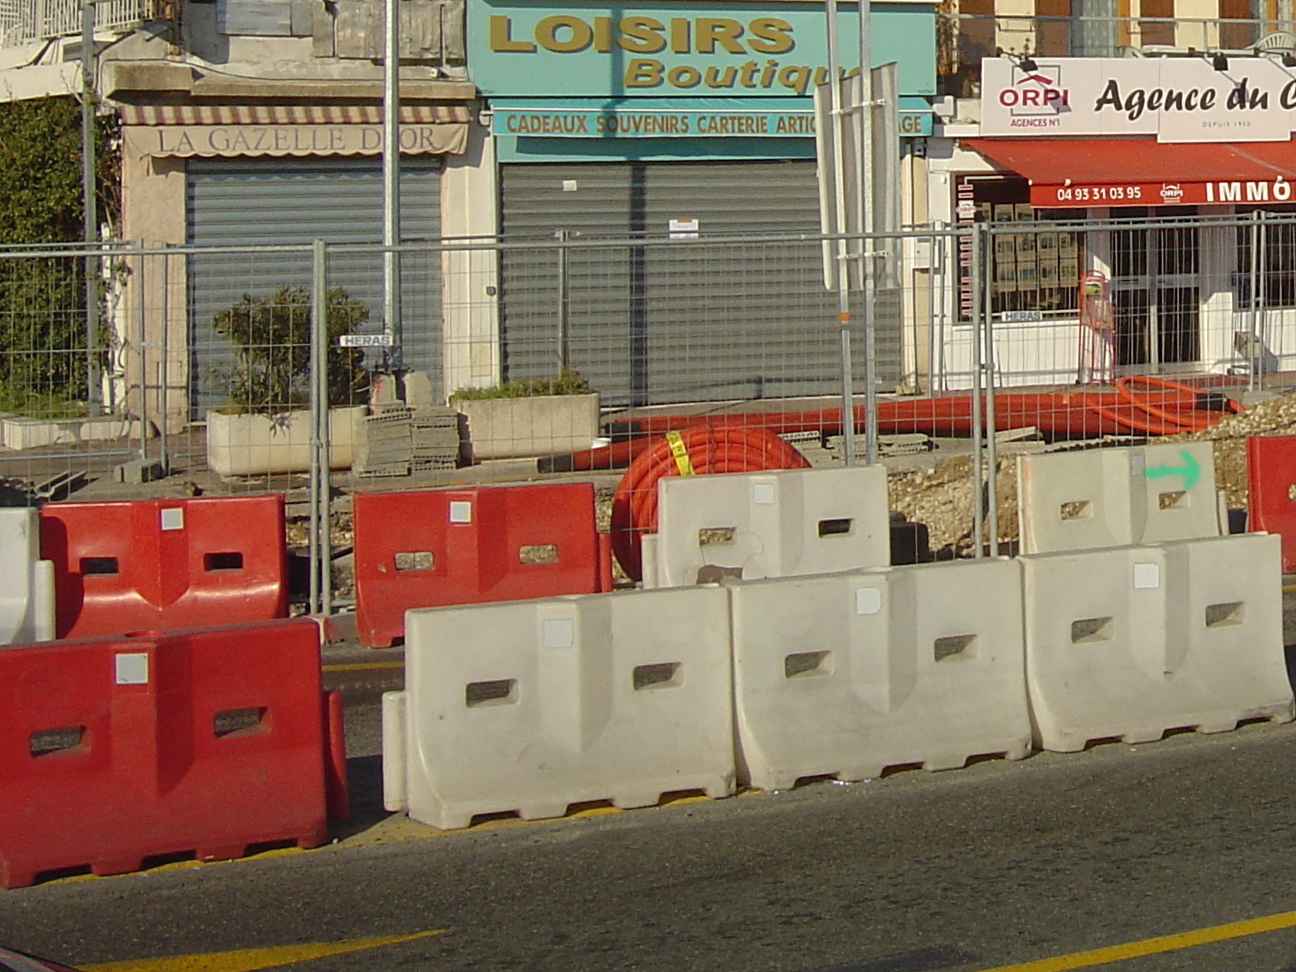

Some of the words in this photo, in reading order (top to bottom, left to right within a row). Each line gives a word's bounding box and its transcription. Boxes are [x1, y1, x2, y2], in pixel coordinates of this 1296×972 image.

[489, 14, 796, 54] LOISIRS
[999, 88, 1070, 107] ORPI
[1094, 79, 1216, 121] Agence
[1226, 78, 1269, 110] du
[506, 114, 589, 134] CADEAUX
[596, 114, 690, 134] SOUVENIRS
[696, 115, 768, 134] CARTERIE
[1010, 118, 1047, 127] AGENCES
[158, 129, 195, 153] LA
[208, 128, 347, 151] GAZELLE
[1057, 189, 1072, 201] 04
[1074, 188, 1090, 200] 93
[1092, 188, 1107, 200] 31
[1109, 187, 1124, 199] 03
[1127, 186, 1142, 198] 95
[1005, 311, 1041, 322] HERAS
[345, 336, 390, 346] HERAS
